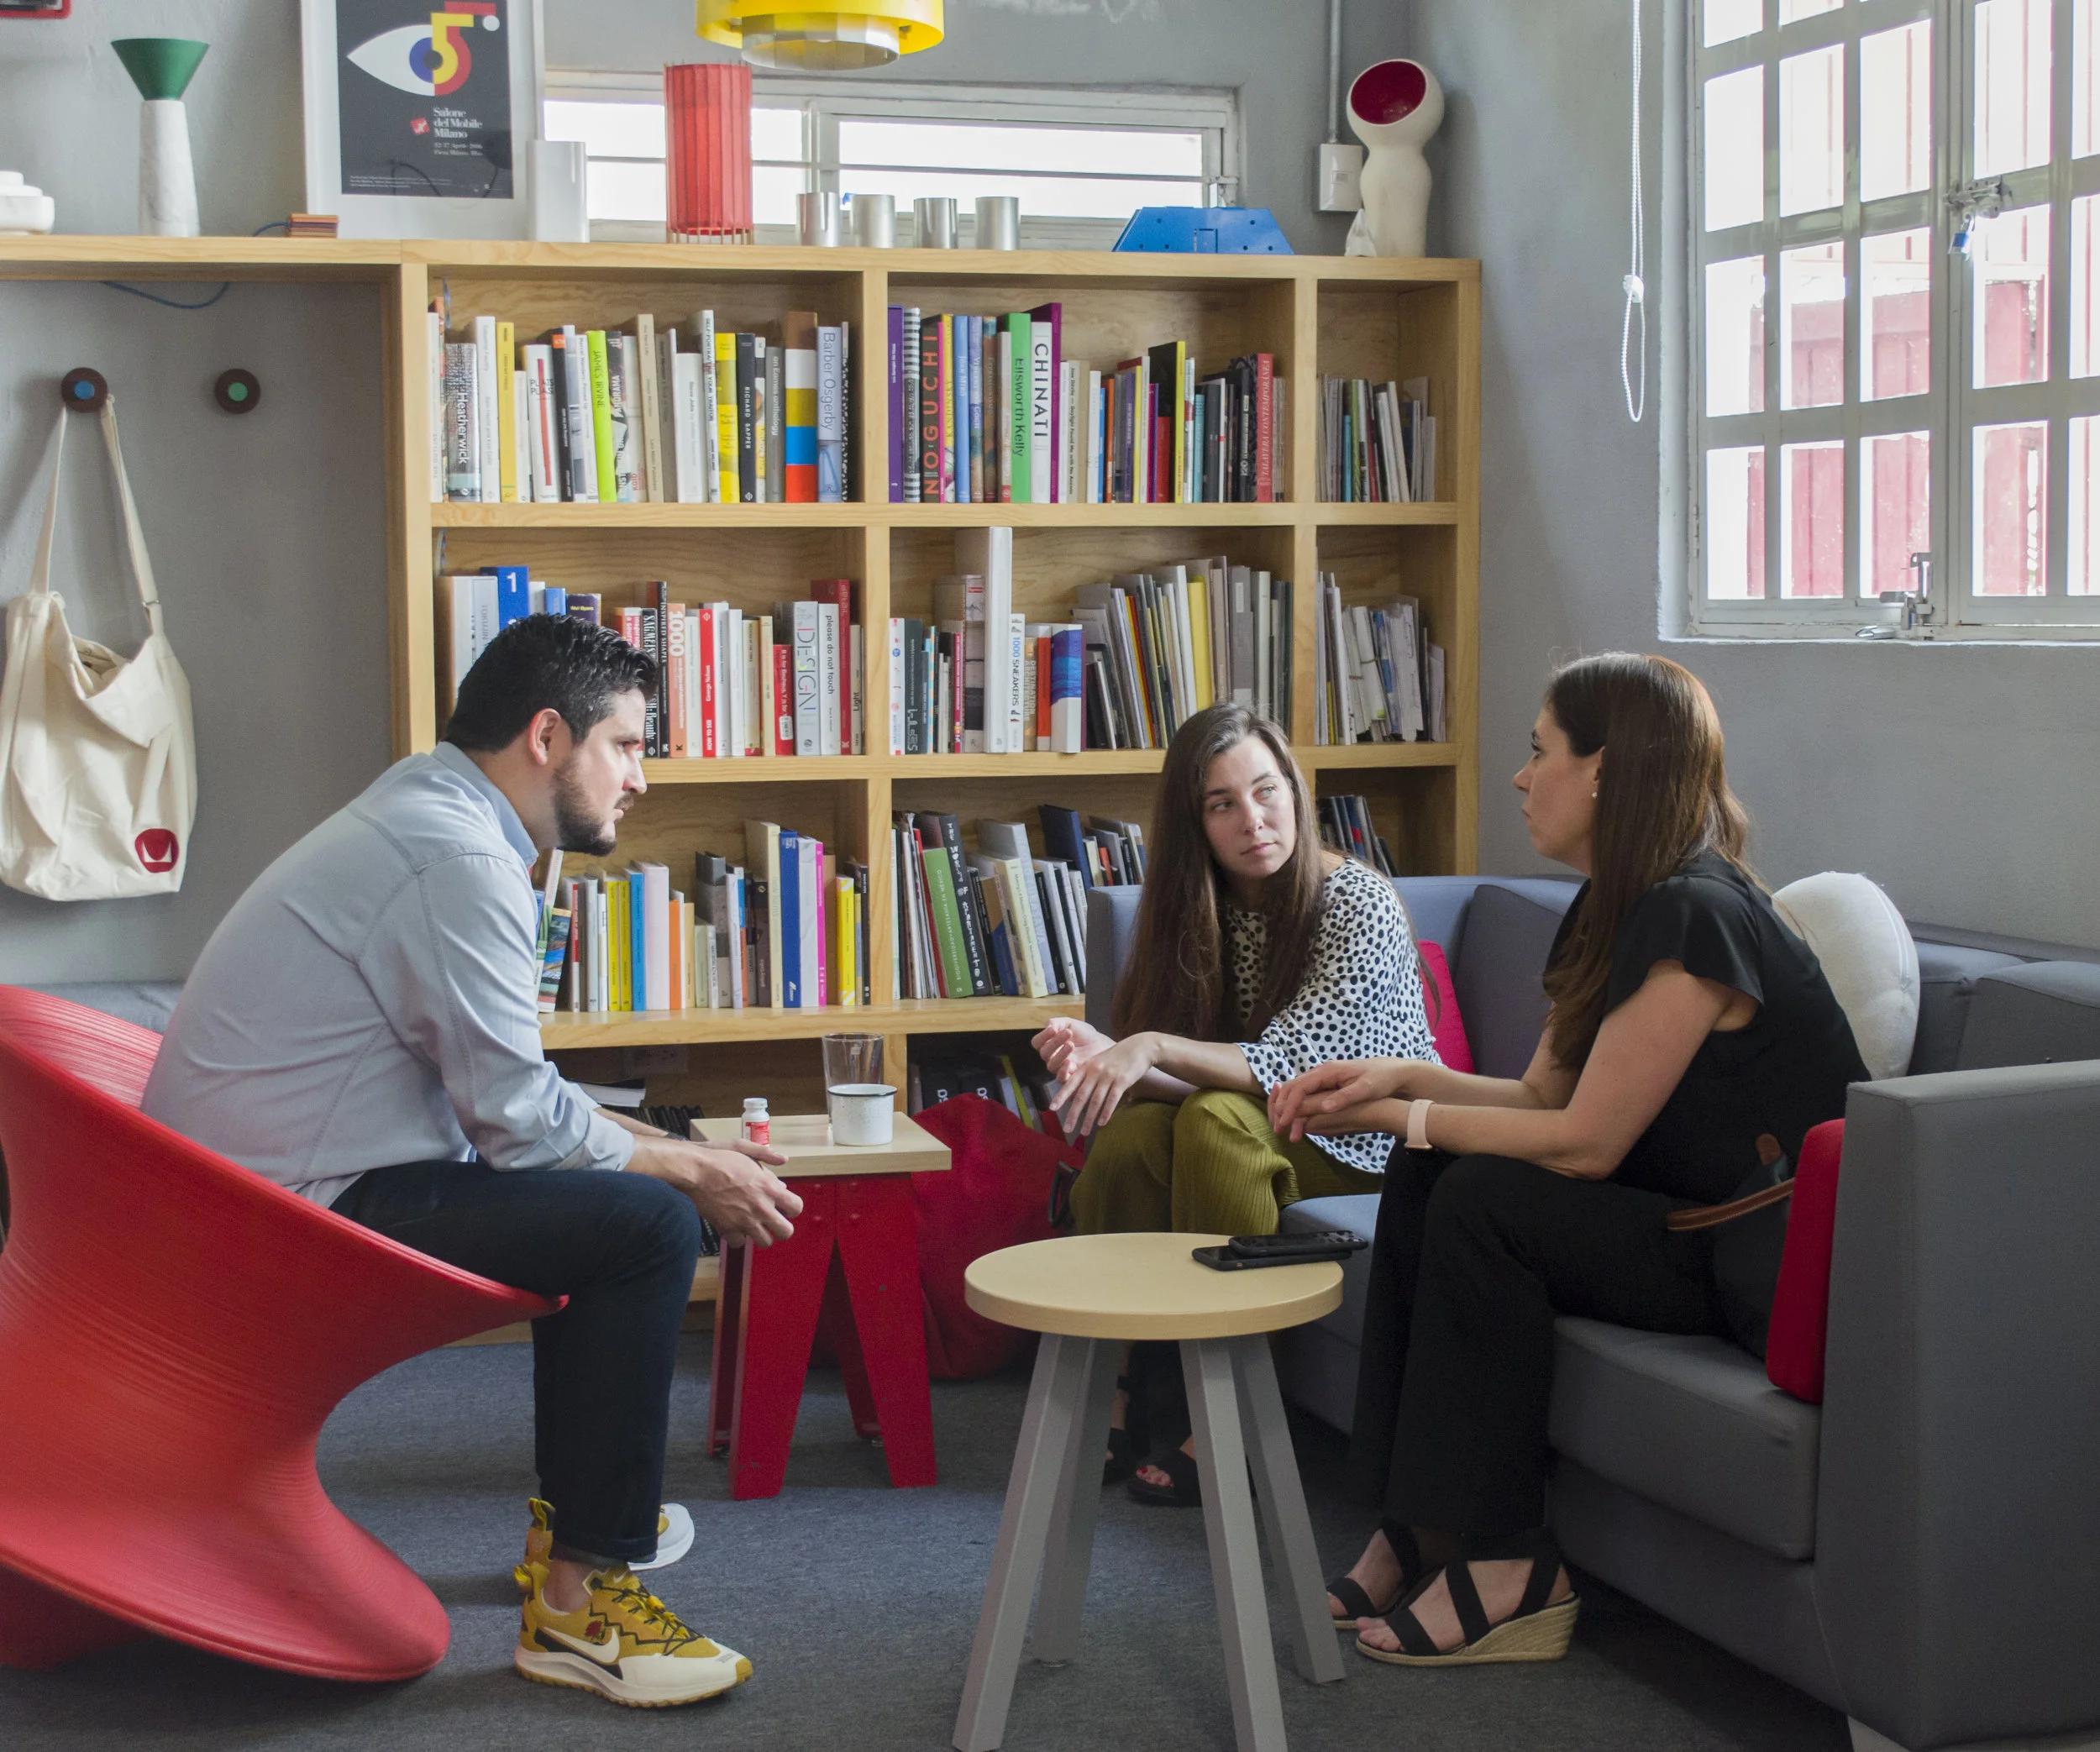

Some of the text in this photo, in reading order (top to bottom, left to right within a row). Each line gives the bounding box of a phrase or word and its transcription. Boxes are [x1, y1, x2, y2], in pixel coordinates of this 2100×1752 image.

[433, 107, 466, 118] Salone
[433, 118, 483, 129] del Mobile
[433, 128, 468, 139] Milano
[592, 350, 606, 409] JAMES IRVINE
[820, 332, 837, 431] Barber Osgerby
[1034, 343, 1049, 438] CHINATI
[771, 396, 780, 436] anthology
[921, 335, 939, 495] NOGUCHI
[1012, 358, 1026, 456] Ellsworth Kelly
[457, 391, 469, 464] Heatherwick
[507, 572, 517, 593] 1
[669, 611, 685, 657] 1000
[825, 615, 833, 642] please
[827, 643, 834, 653] do
[1012, 636, 1021, 658] 1000
[853, 692, 862, 711] Light
